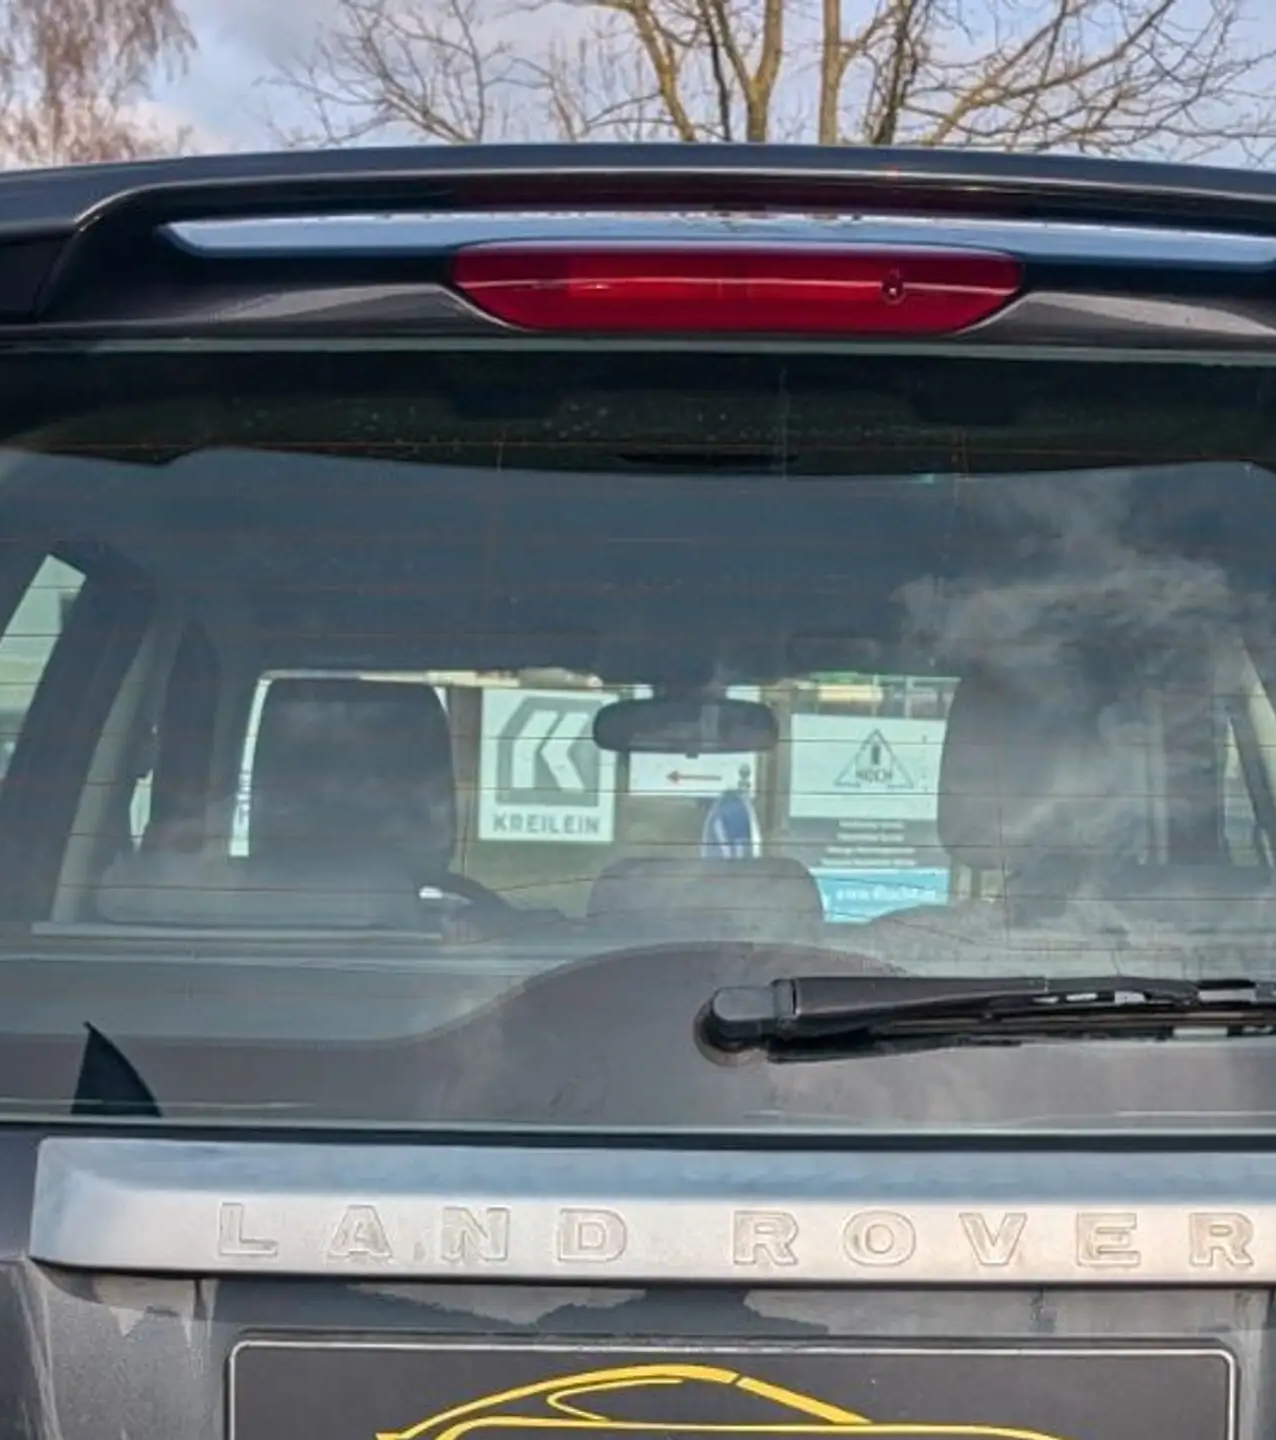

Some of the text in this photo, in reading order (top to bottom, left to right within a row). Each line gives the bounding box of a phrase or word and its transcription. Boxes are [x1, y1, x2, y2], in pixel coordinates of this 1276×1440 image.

[493, 813, 600, 834] KREILEIN
[217, 1201, 1258, 1268] LAND ROVER
